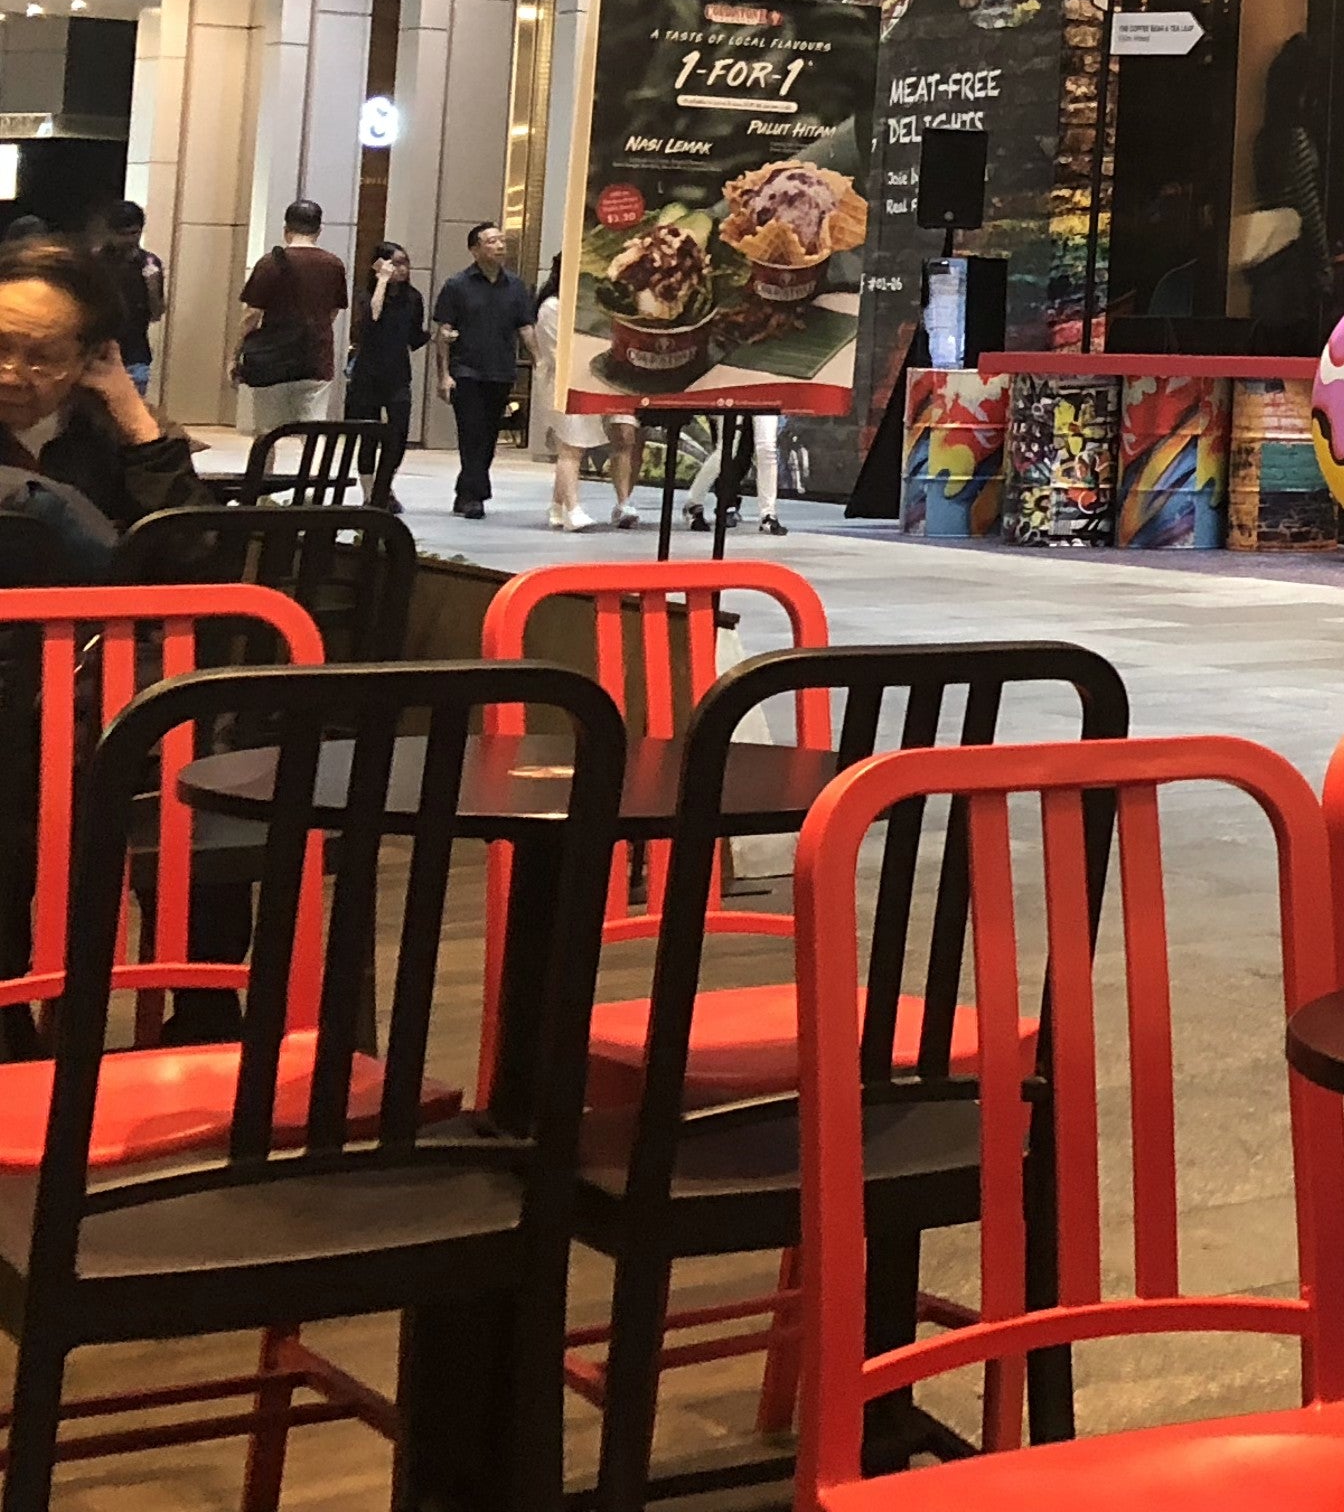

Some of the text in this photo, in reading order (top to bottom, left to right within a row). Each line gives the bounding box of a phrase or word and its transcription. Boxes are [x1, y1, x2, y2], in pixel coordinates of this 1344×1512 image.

[650, 29, 660, 39] A
[728, 35, 766, 48] LOCAL
[889, 68, 1002, 107] MEAT-FREE
